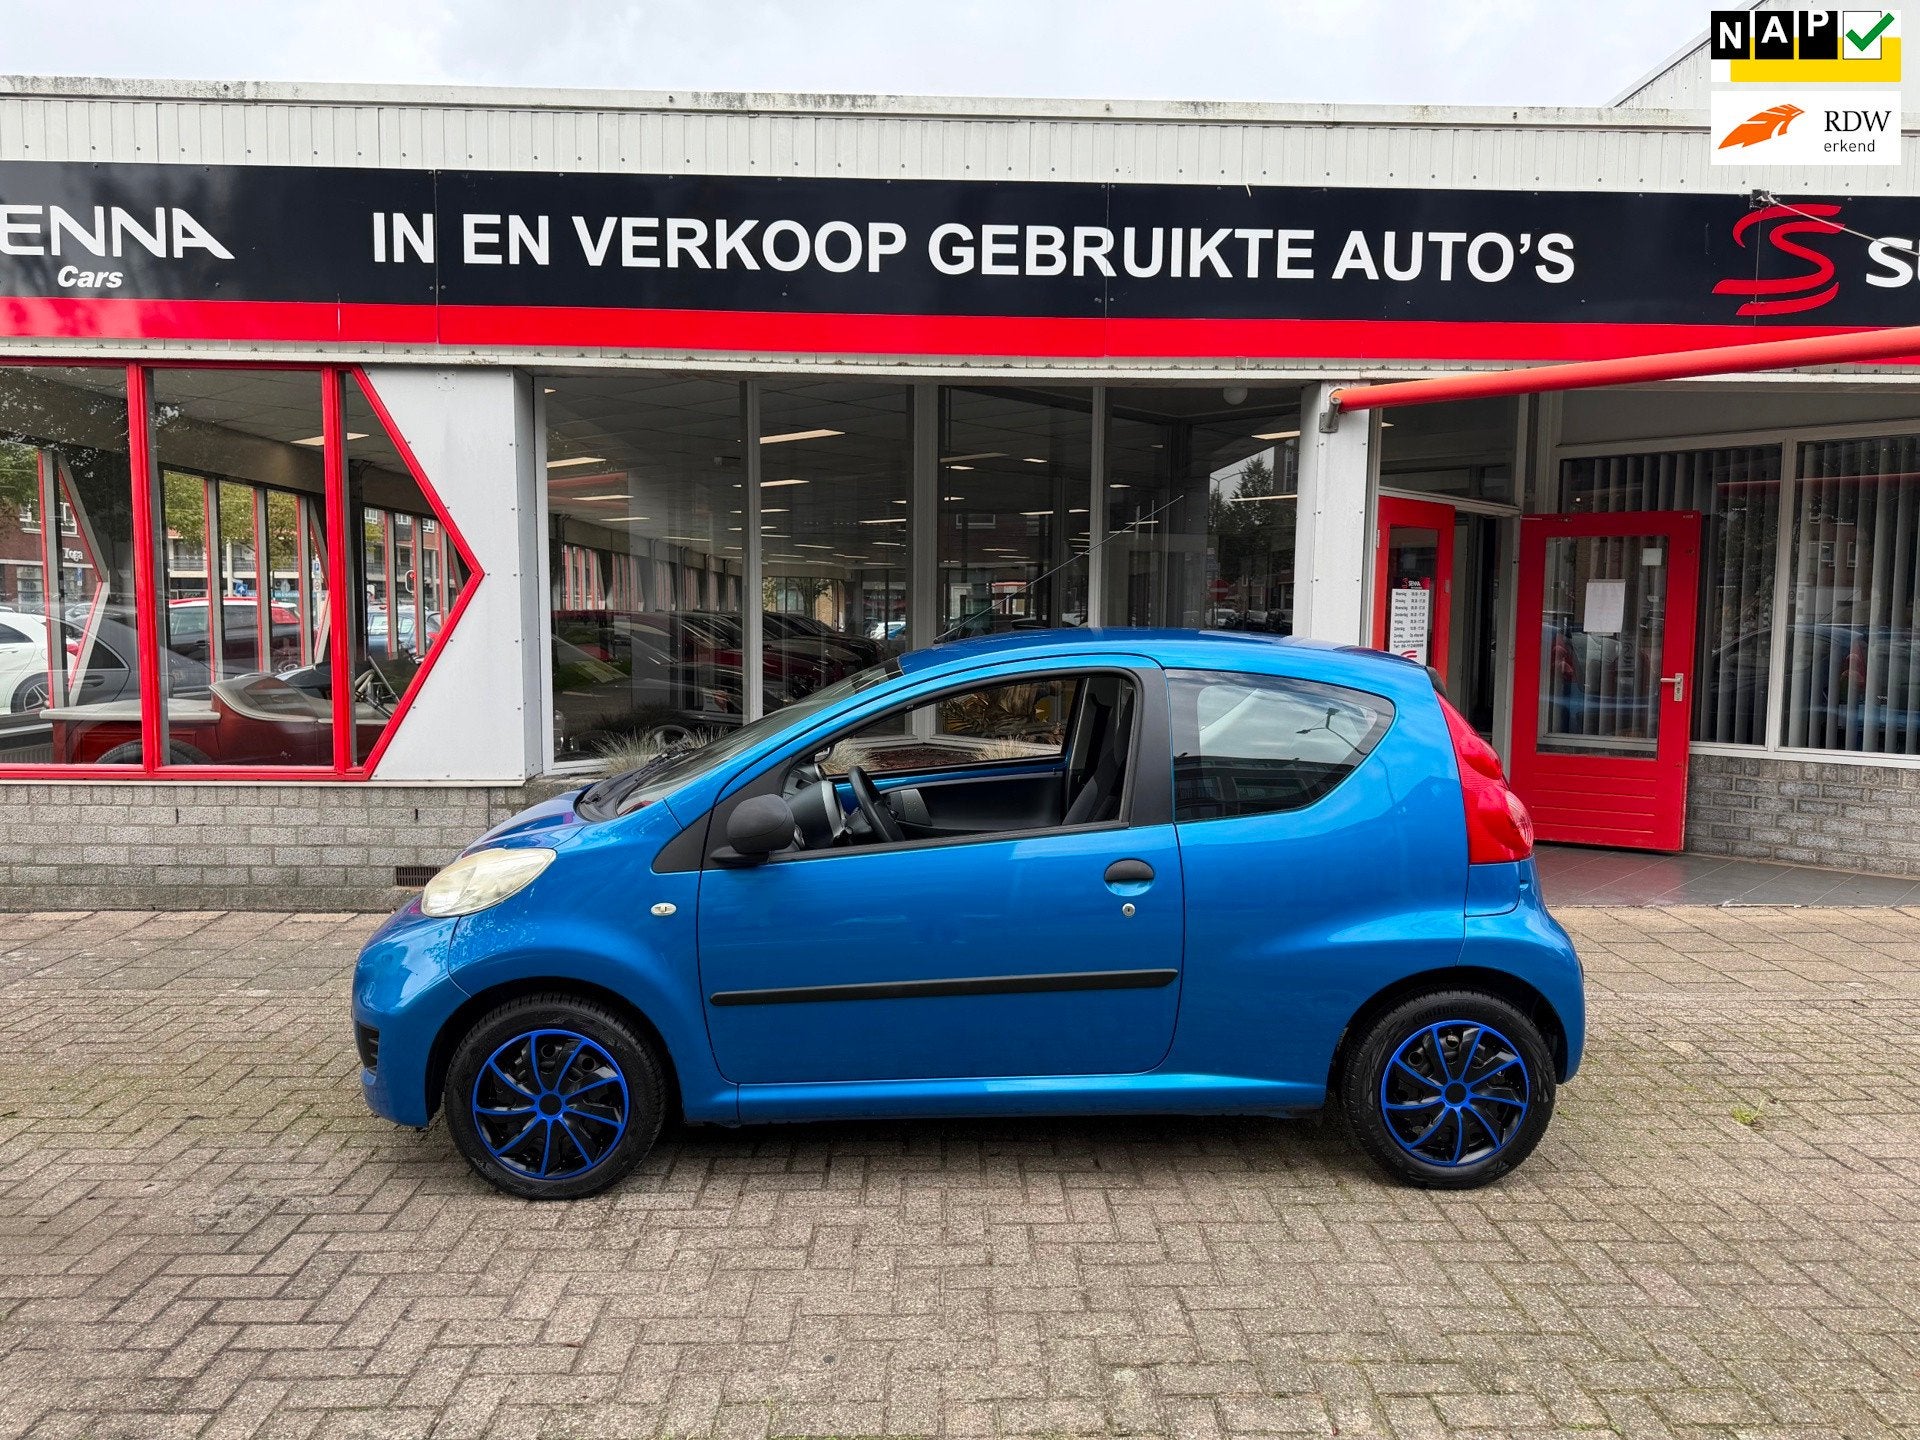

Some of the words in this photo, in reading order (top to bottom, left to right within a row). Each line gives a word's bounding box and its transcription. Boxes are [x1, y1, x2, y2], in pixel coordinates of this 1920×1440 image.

[373, 212, 435, 263] IN
[463, 213, 550, 265] EN
[571, 215, 907, 273] VERKOOP
[928, 223, 1315, 279] GEBRUIKTE
[1331, 230, 1575, 283] AUTO'S
[1866, 237, 1920, 288] S
[57, 266, 123, 290] Cars
